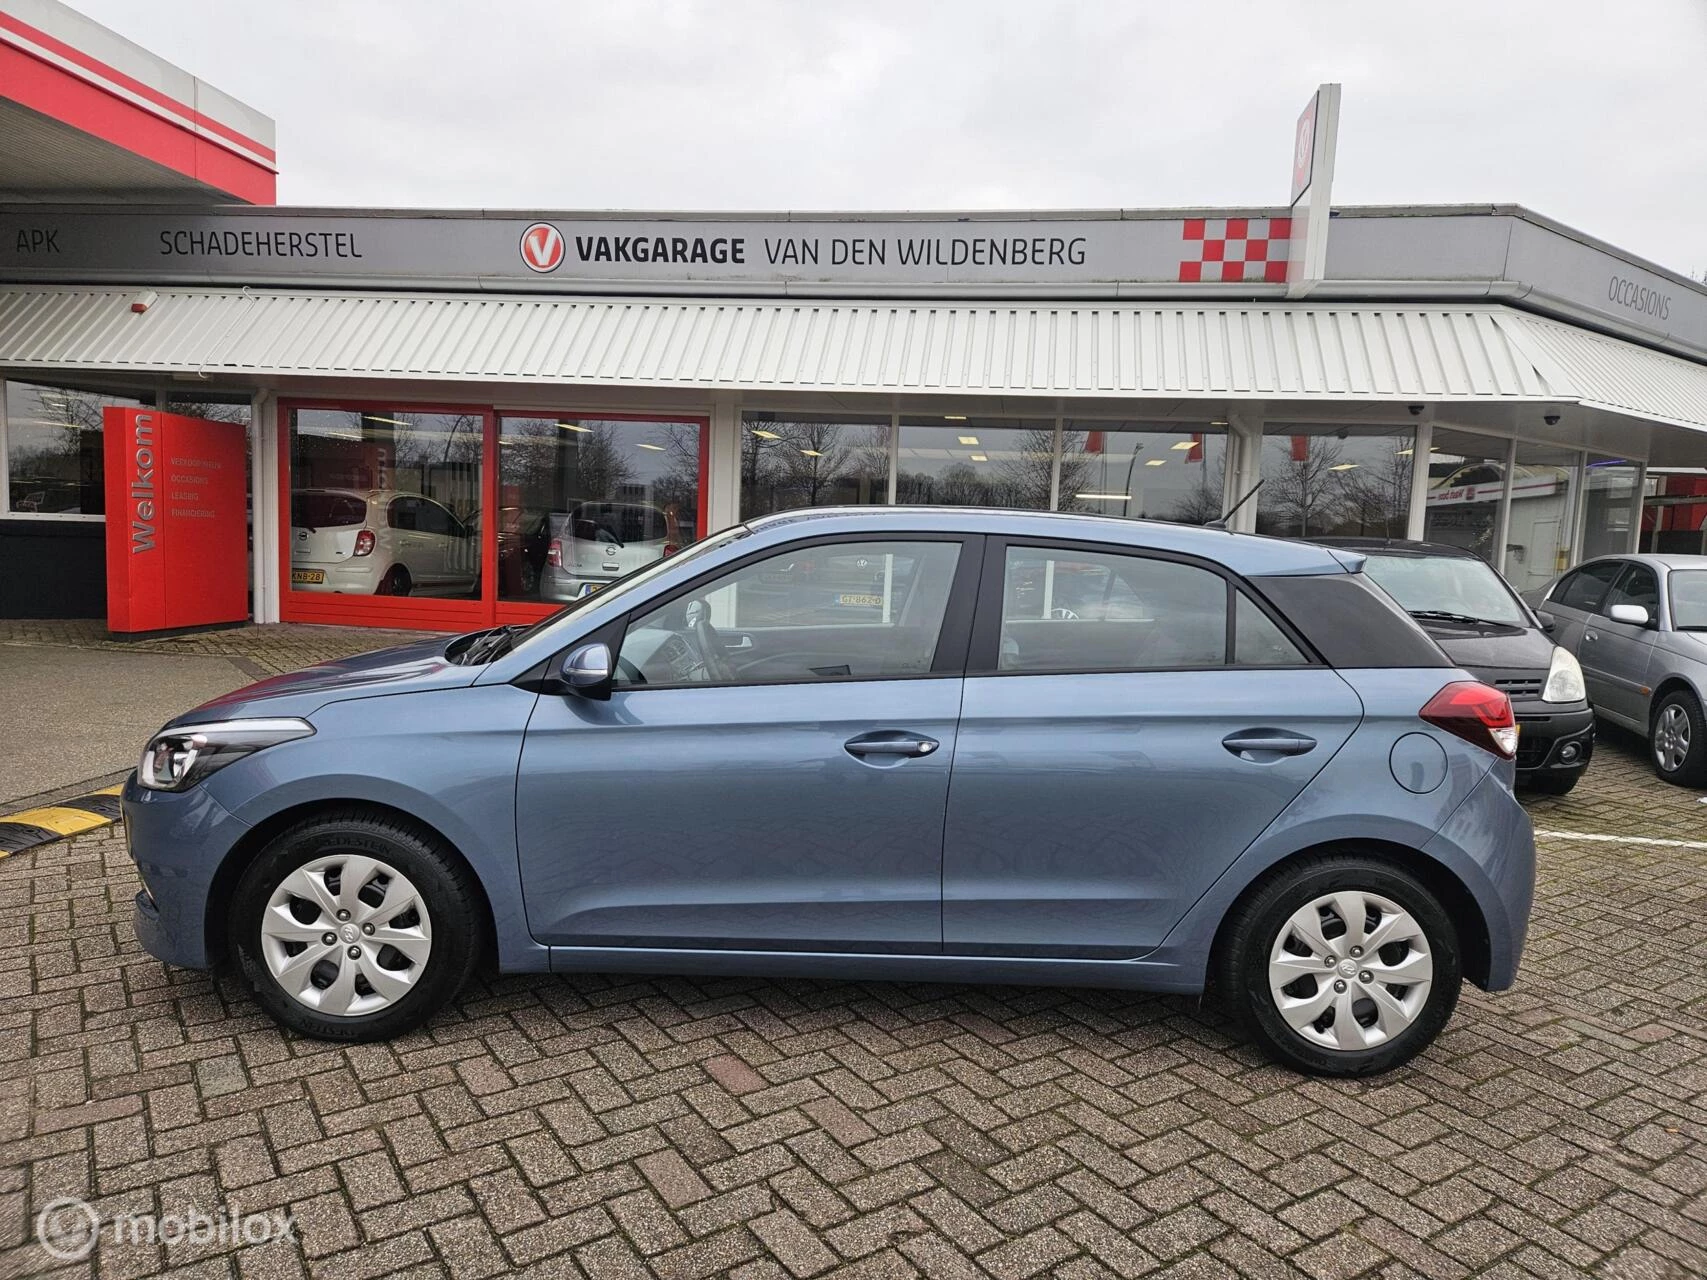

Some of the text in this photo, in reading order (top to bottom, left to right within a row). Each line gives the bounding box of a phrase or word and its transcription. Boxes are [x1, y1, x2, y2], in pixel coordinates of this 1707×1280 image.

[16, 229, 60, 253] APK
[160, 230, 362, 258] SCHADEHERSTEL
[575, 236, 1087, 265] VAKGARAGE VAN DEN WILDENBERG
[1608, 276, 1671, 320] OCCASIONS
[132, 414, 155, 554] Welkom
